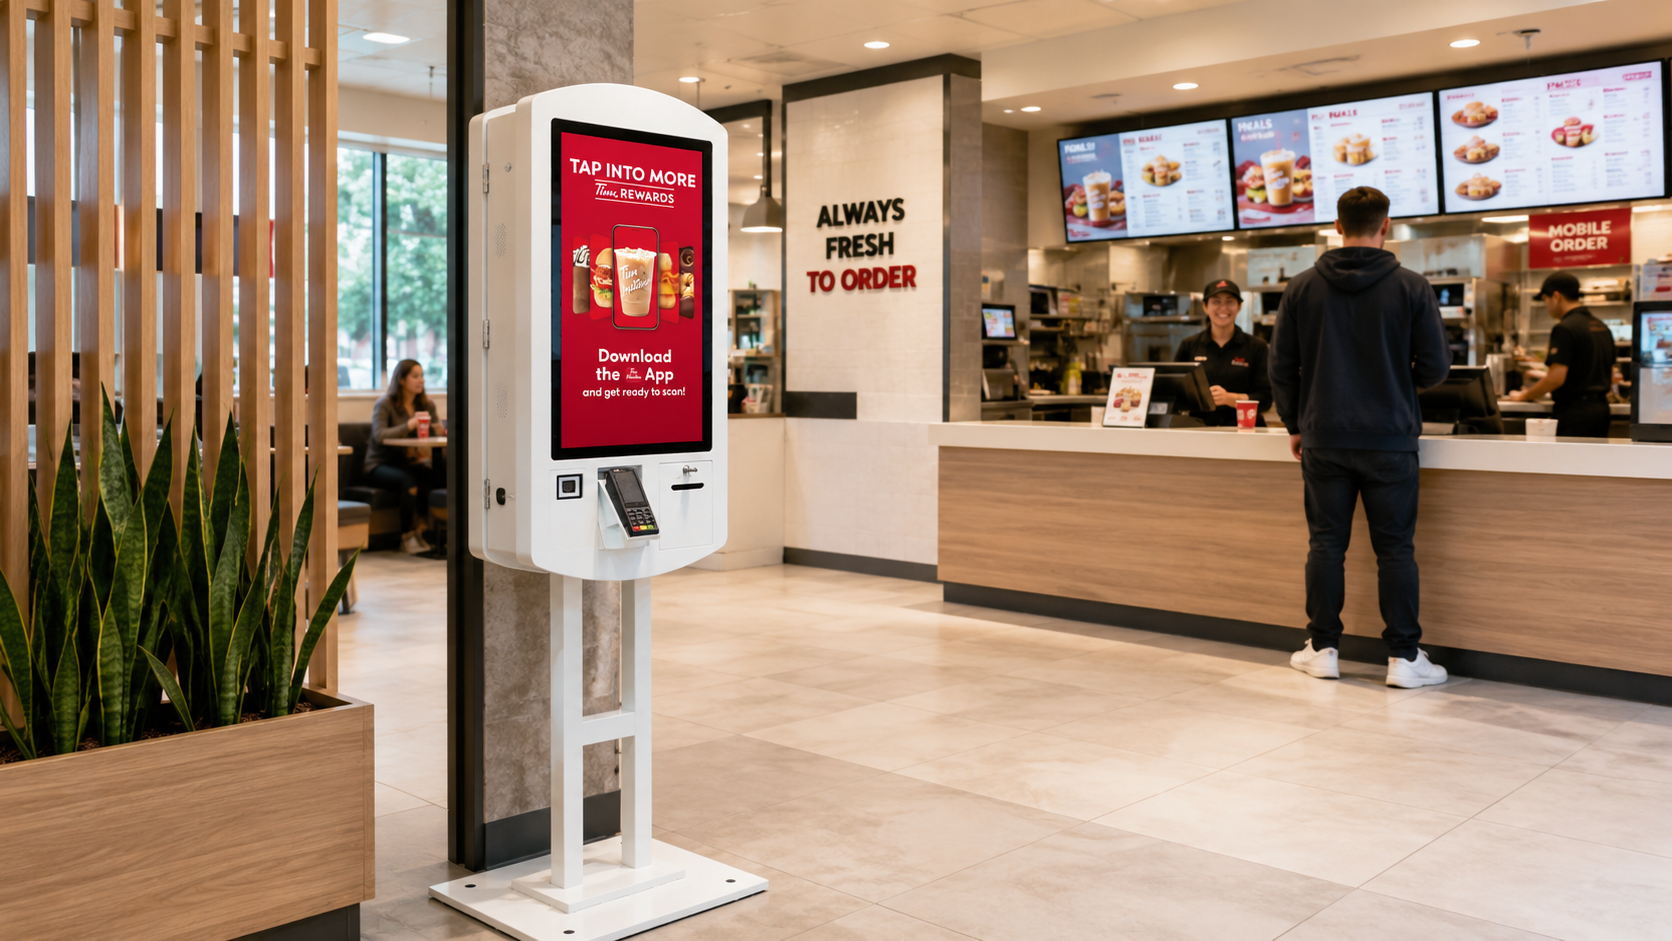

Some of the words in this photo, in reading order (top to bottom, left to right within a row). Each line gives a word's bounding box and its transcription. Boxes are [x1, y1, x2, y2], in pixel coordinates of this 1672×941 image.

[569, 158, 602, 176] TAP
[606, 163, 645, 181] INTO
[650, 168, 696, 188] MORE
[620, 188, 675, 204] REWARDS
[816, 197, 905, 228] ALWAYS
[1548, 220, 1612, 237] MOBILE
[826, 231, 894, 260] FRESH
[1550, 237, 1608, 252] ORDER
[806, 269, 836, 293] TO
[840, 264, 917, 291] ORDER
[598, 348, 672, 363] Download
[595, 366, 621, 381] the
[644, 366, 674, 385] App
[582, 387, 602, 397] and
[604, 387, 620, 400] get
[622, 387, 650, 399] ready
[651, 387, 660, 396] to
[662, 386, 686, 396] scan!
